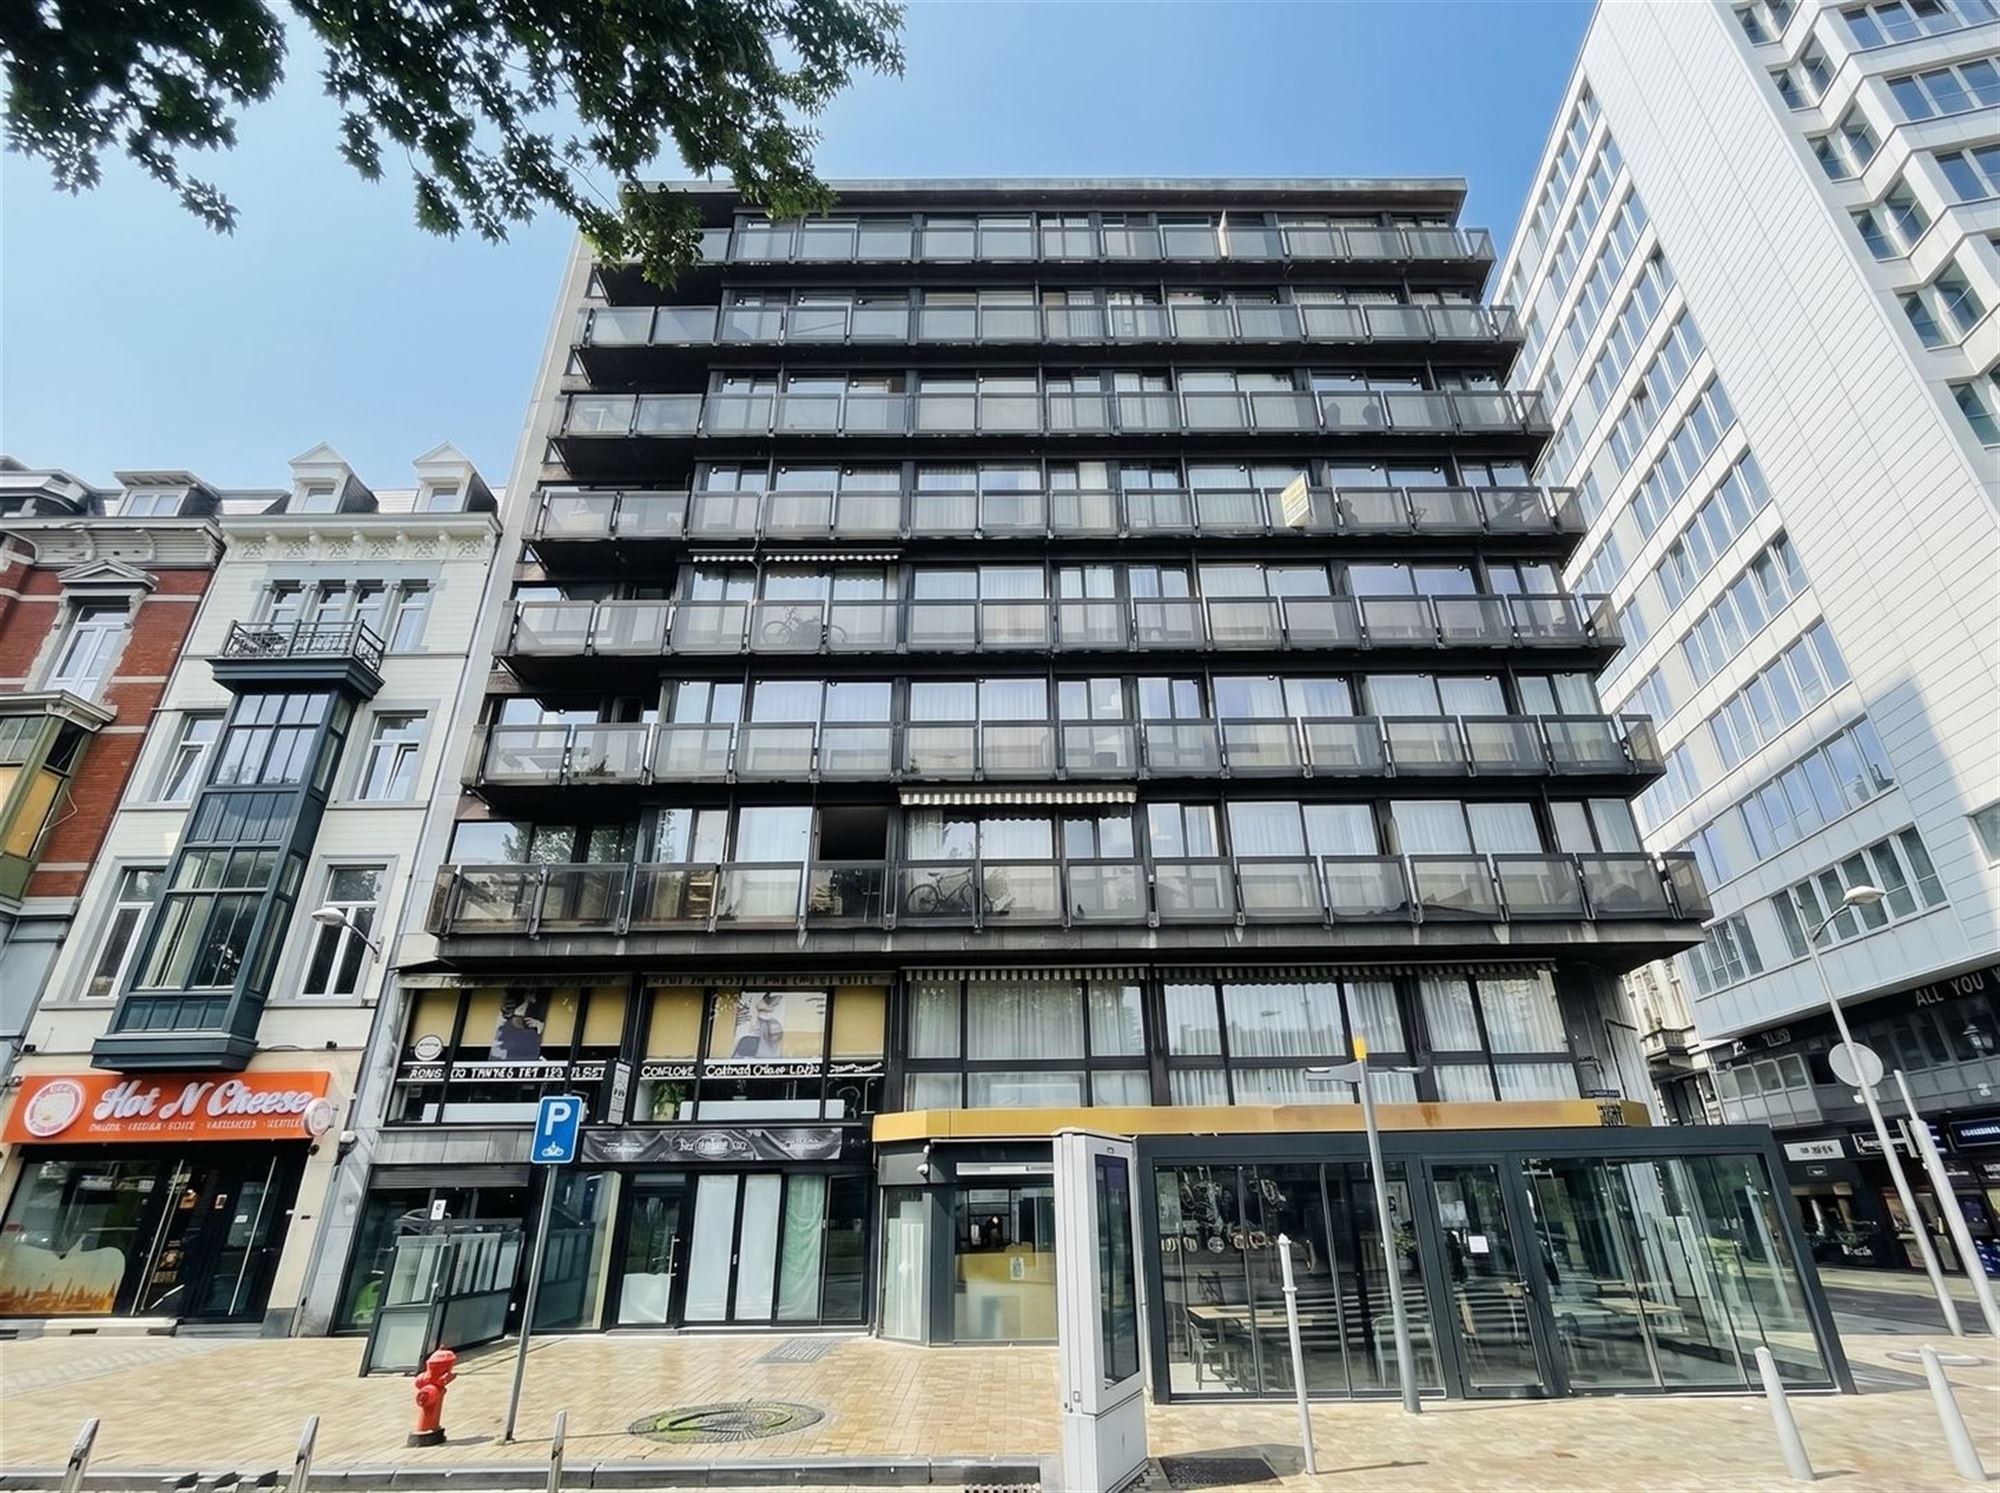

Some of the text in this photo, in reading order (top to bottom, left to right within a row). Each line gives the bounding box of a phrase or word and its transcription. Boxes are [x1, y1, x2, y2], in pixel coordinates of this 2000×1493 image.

[1915, 985, 1944, 1007] ALL
[1950, 972, 1985, 996] YOU
[93, 1079, 161, 1121] Hot
[158, 1081, 215, 1120] N
[206, 1079, 313, 1117] Cheese
[545, 1102, 571, 1136] P
